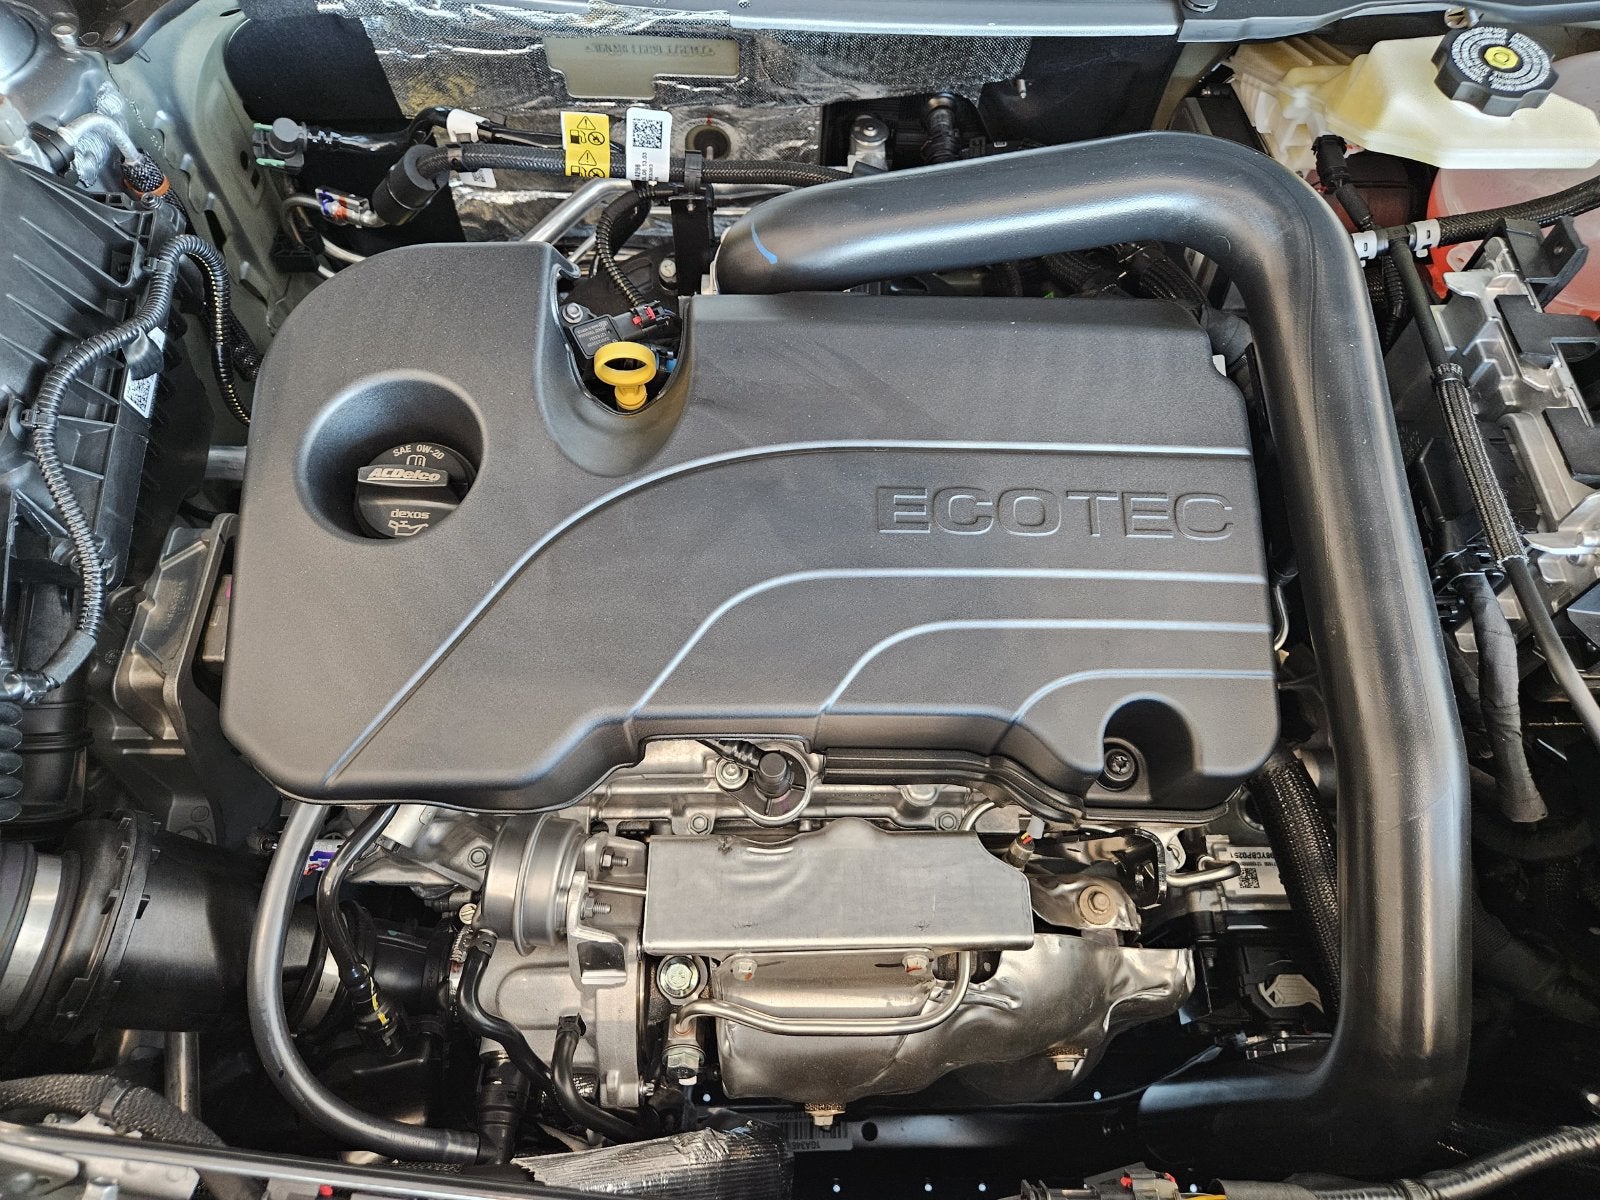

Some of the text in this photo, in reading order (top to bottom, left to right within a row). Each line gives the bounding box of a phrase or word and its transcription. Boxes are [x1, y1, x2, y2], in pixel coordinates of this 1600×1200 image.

[392, 444, 445, 460] SAE 0W-20
[367, 467, 441, 481] ACDelco
[390, 508, 431, 519] dexos
[875, 484, 1234, 541] ECOTEC
